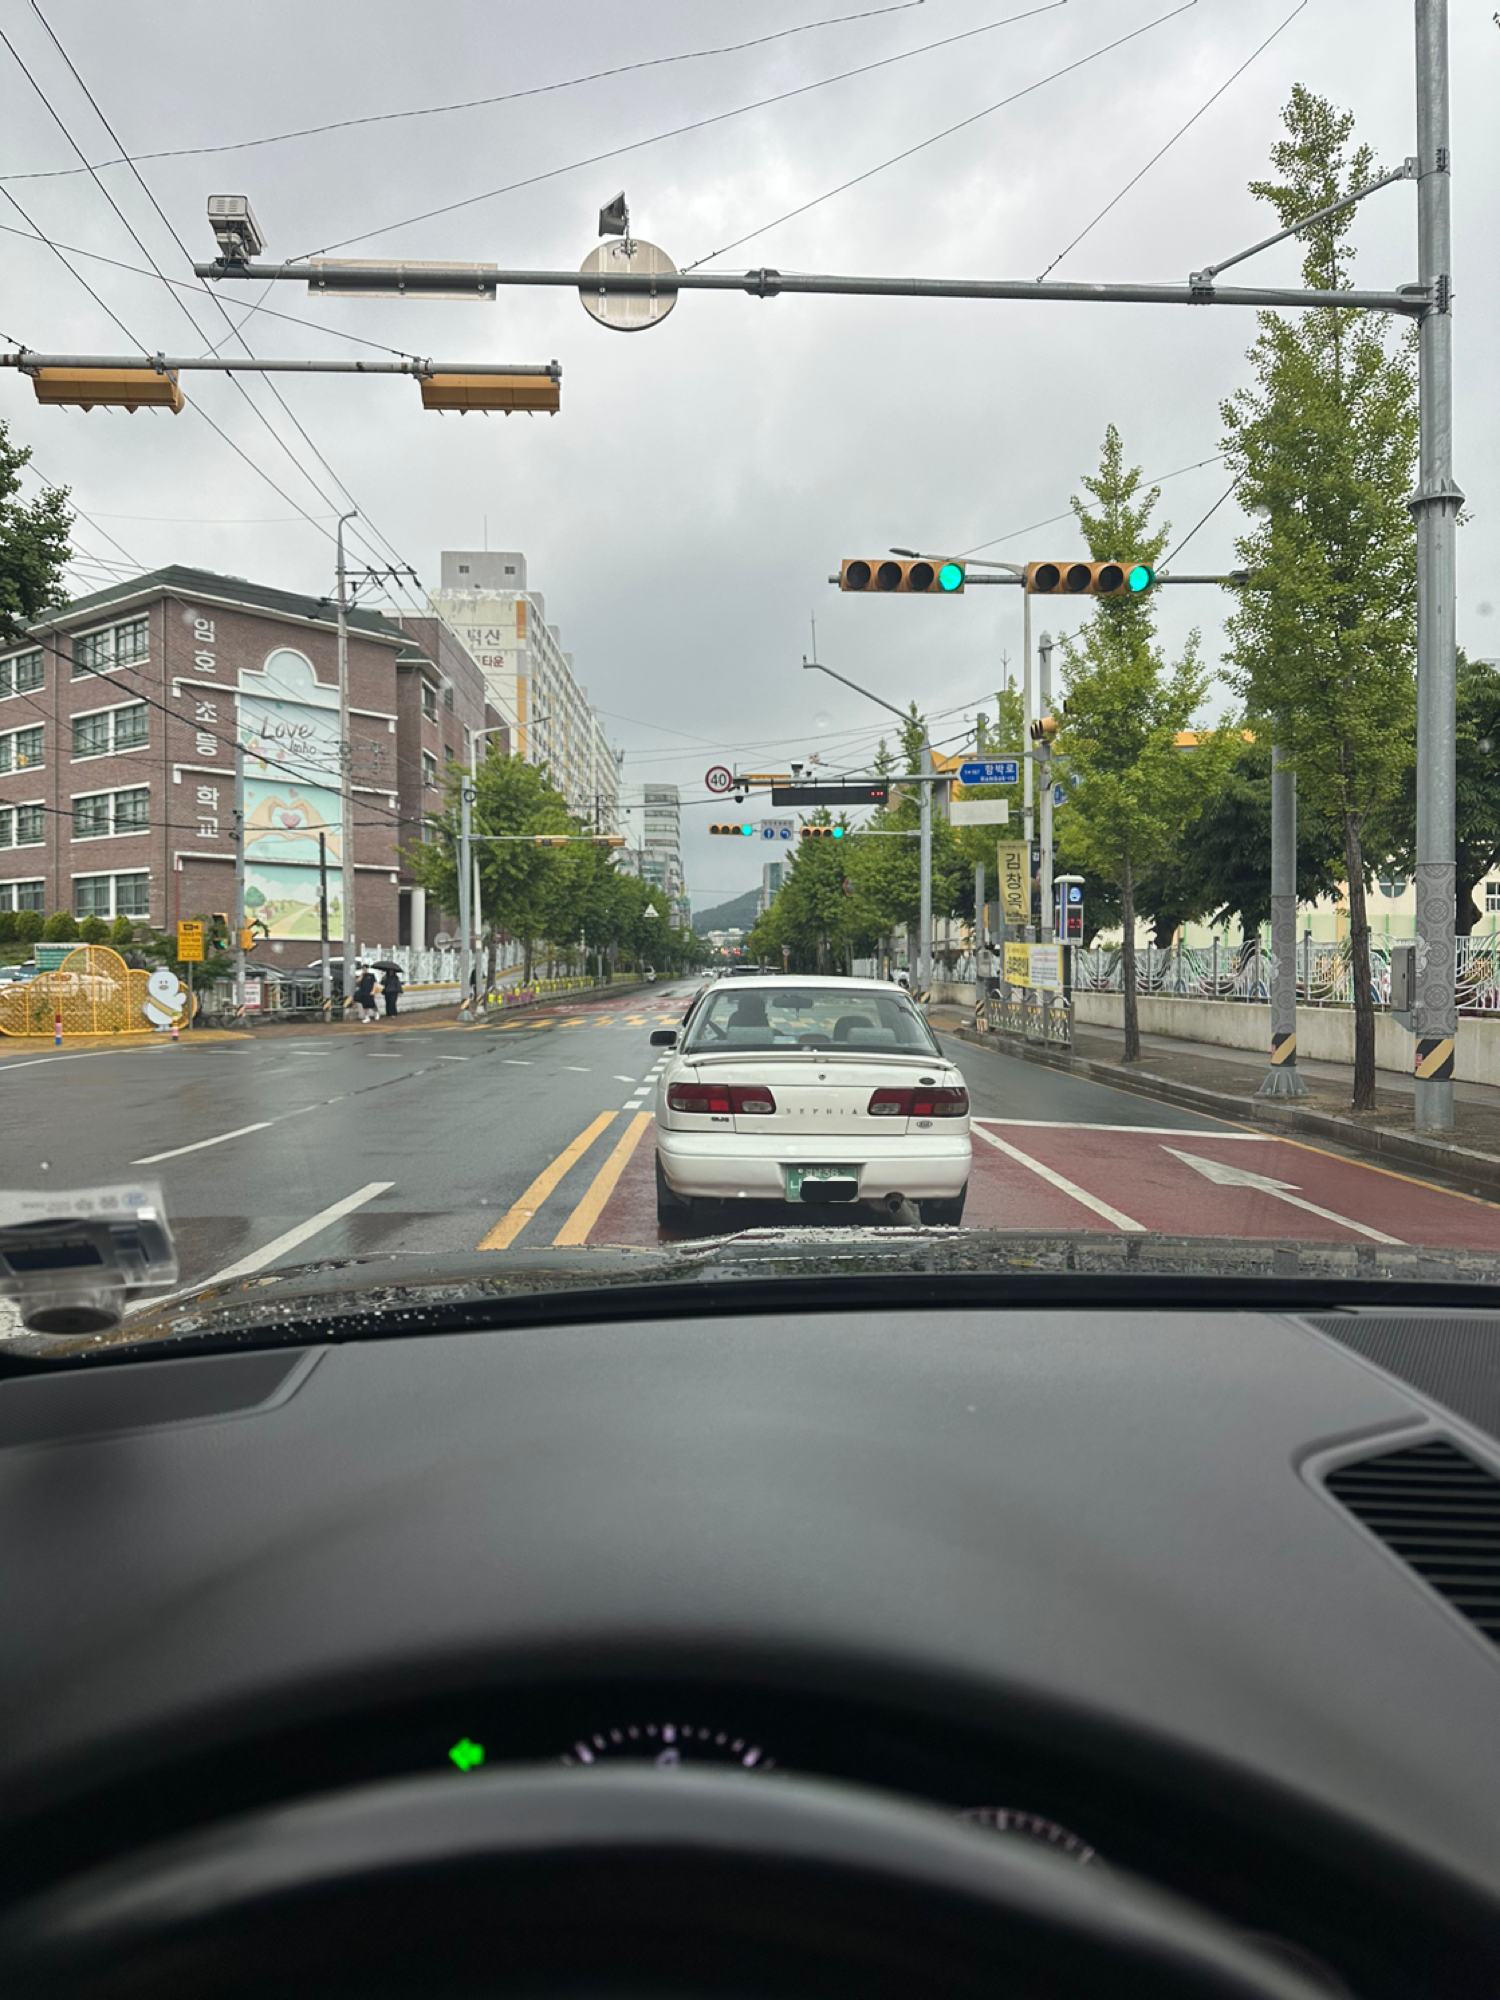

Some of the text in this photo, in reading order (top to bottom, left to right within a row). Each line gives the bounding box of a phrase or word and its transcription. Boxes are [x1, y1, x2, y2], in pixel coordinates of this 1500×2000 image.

[261, 716, 316, 739] Love
[984, 763, 1015, 776] 함박로
[711, 773, 727, 786] 40
[1005, 853, 1023, 909] 김창옥
[786, 1107, 858, 1115] SEPHIA
